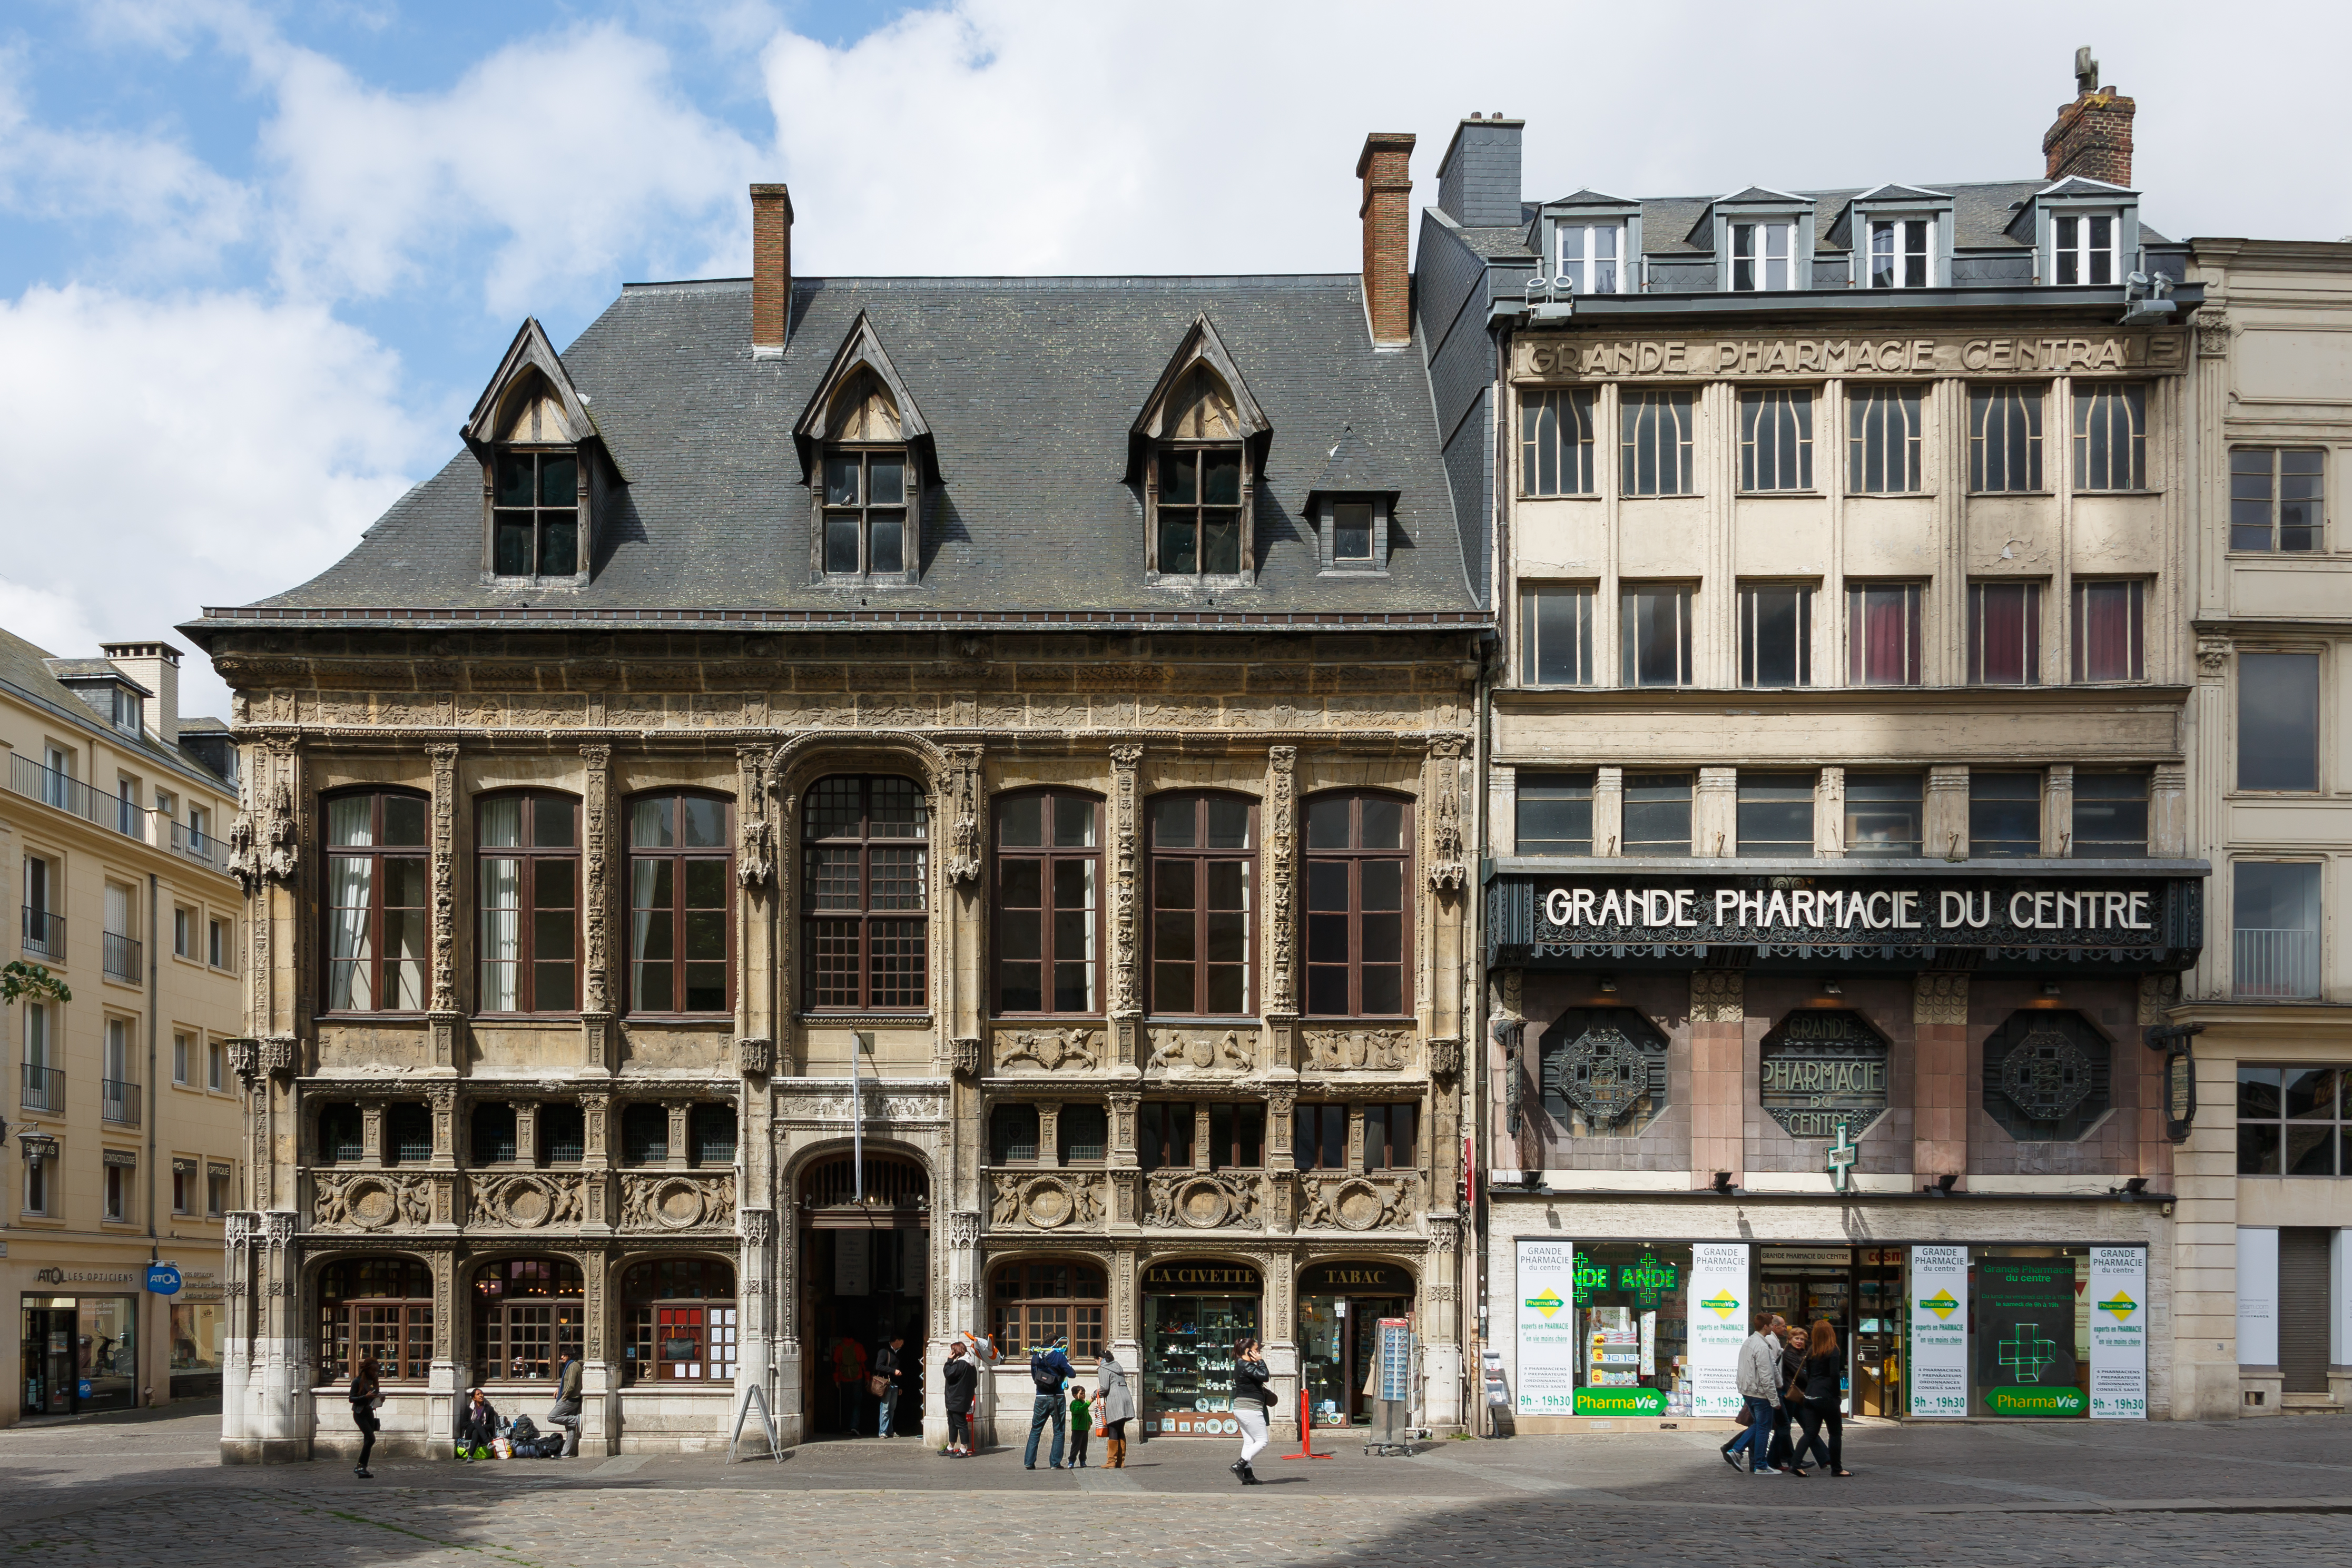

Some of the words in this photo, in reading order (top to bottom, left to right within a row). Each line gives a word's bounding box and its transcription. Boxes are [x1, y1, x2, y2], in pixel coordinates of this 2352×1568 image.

[1528, 342, 1687, 373] GRANDE
[1714, 340, 1935, 373] PHARMACIE
[1961, 337, 2175, 370] CENTRALE
[1546, 889, 1697, 926] GRANDE
[1716, 890, 1921, 928] PHARMACIE
[1940, 891, 1990, 928] DU
[2010, 891, 2151, 929] CENTRE
[1790, 1018, 1853, 1039] GRANDE
[1763, 1062, 1883, 1091] PHARMACIE
[1810, 1096, 1831, 1108] DU
[104, 1153, 135, 1165] CONTACTOLOGIE
[209, 1166, 229, 1176] OPTIQUE
[1704, 1248, 1738, 1256] GRANDE
[1922, 1248, 1957, 1256] GRANDE
[2100, 1249, 2136, 1258] GRANDE
[1697, 1257, 1745, 1265] PHARMACIE
[1915, 1257, 1964, 1265] PHARMACIE
[2093, 1258, 2143, 1267] PHARMACIE
[1984, 1265, 2019, 1273] Grande
[2022, 1265, 2073, 1274] Pharmacie
[37, 1267, 67, 1285] ATOL
[68, 1273, 83, 1281] LES
[87, 1273, 133, 1282] OPTICIENS
[150, 1273, 178, 1284] ATOL
[1149, 1269, 1171, 1282] LA
[1178, 1269, 1255, 1283] CIVETTE
[1325, 1270, 1385, 1284] TABAC
[1622, 1269, 1675, 1287] ANDE
[1520, 1395, 1532, 1405] 9h
[1542, 1395, 1570, 1406] 19h30
[1577, 1395, 1658, 1409] PharmaVie
[1695, 1396, 1707, 1406] 9h
[1914, 1396, 1926, 1407] 9h
[1936, 1397, 1965, 1407] 19h30
[1997, 1394, 2079, 1408] PharmaVie
[2093, 1398, 2104, 1409] 9h
[2114, 1398, 2143, 1409] 19h30
